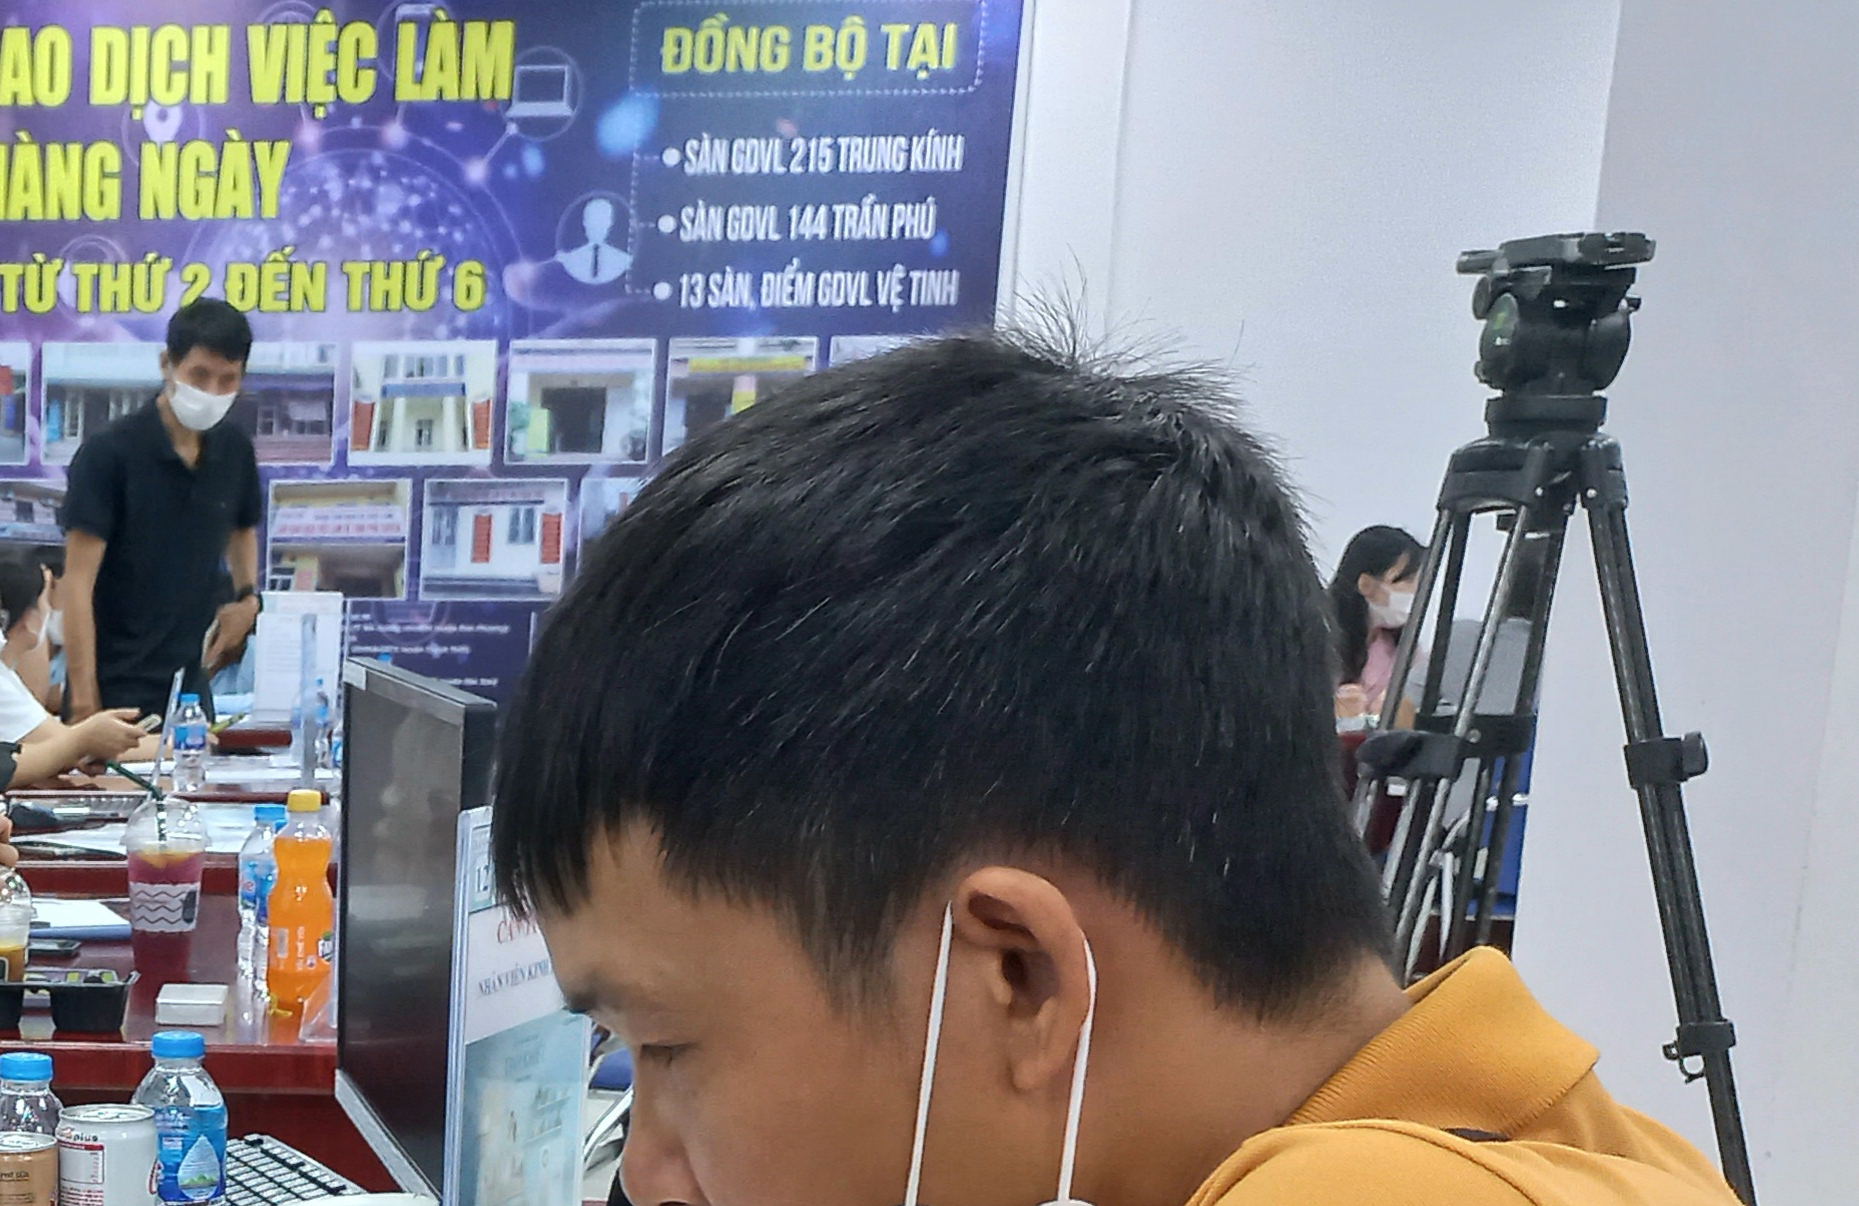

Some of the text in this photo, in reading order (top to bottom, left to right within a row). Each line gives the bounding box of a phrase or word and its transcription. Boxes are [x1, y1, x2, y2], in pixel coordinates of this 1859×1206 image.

[89, 24, 230, 120] DỊCH
[247, 9, 378, 118] VIỆC
[396, 9, 516, 102] LÀM
[661, 12, 958, 80] ĐỒNG BỘ TẠI
[139, 128, 291, 220] NGÀY
[684, 128, 965, 176] SÀN GDVL 215 TRUNG KÍNH
[680, 199, 723, 242] SÀN
[726, 205, 782, 241] GDVL
[789, 203, 830, 240] 144
[891, 196, 937, 240] PHÚ
[73, 252, 172, 313] THỨ
[182, 264, 211, 308] 2
[225, 246, 327, 312] ĐẾN
[343, 249, 446, 312] THỨ
[454, 260, 486, 312] 6
[680, 272, 706, 308] 13
[760, 258, 815, 308] ĐIỂM
[818, 271, 872, 307] GDVL
[877, 264, 907, 312] VỆ
[909, 270, 960, 306] TINH
